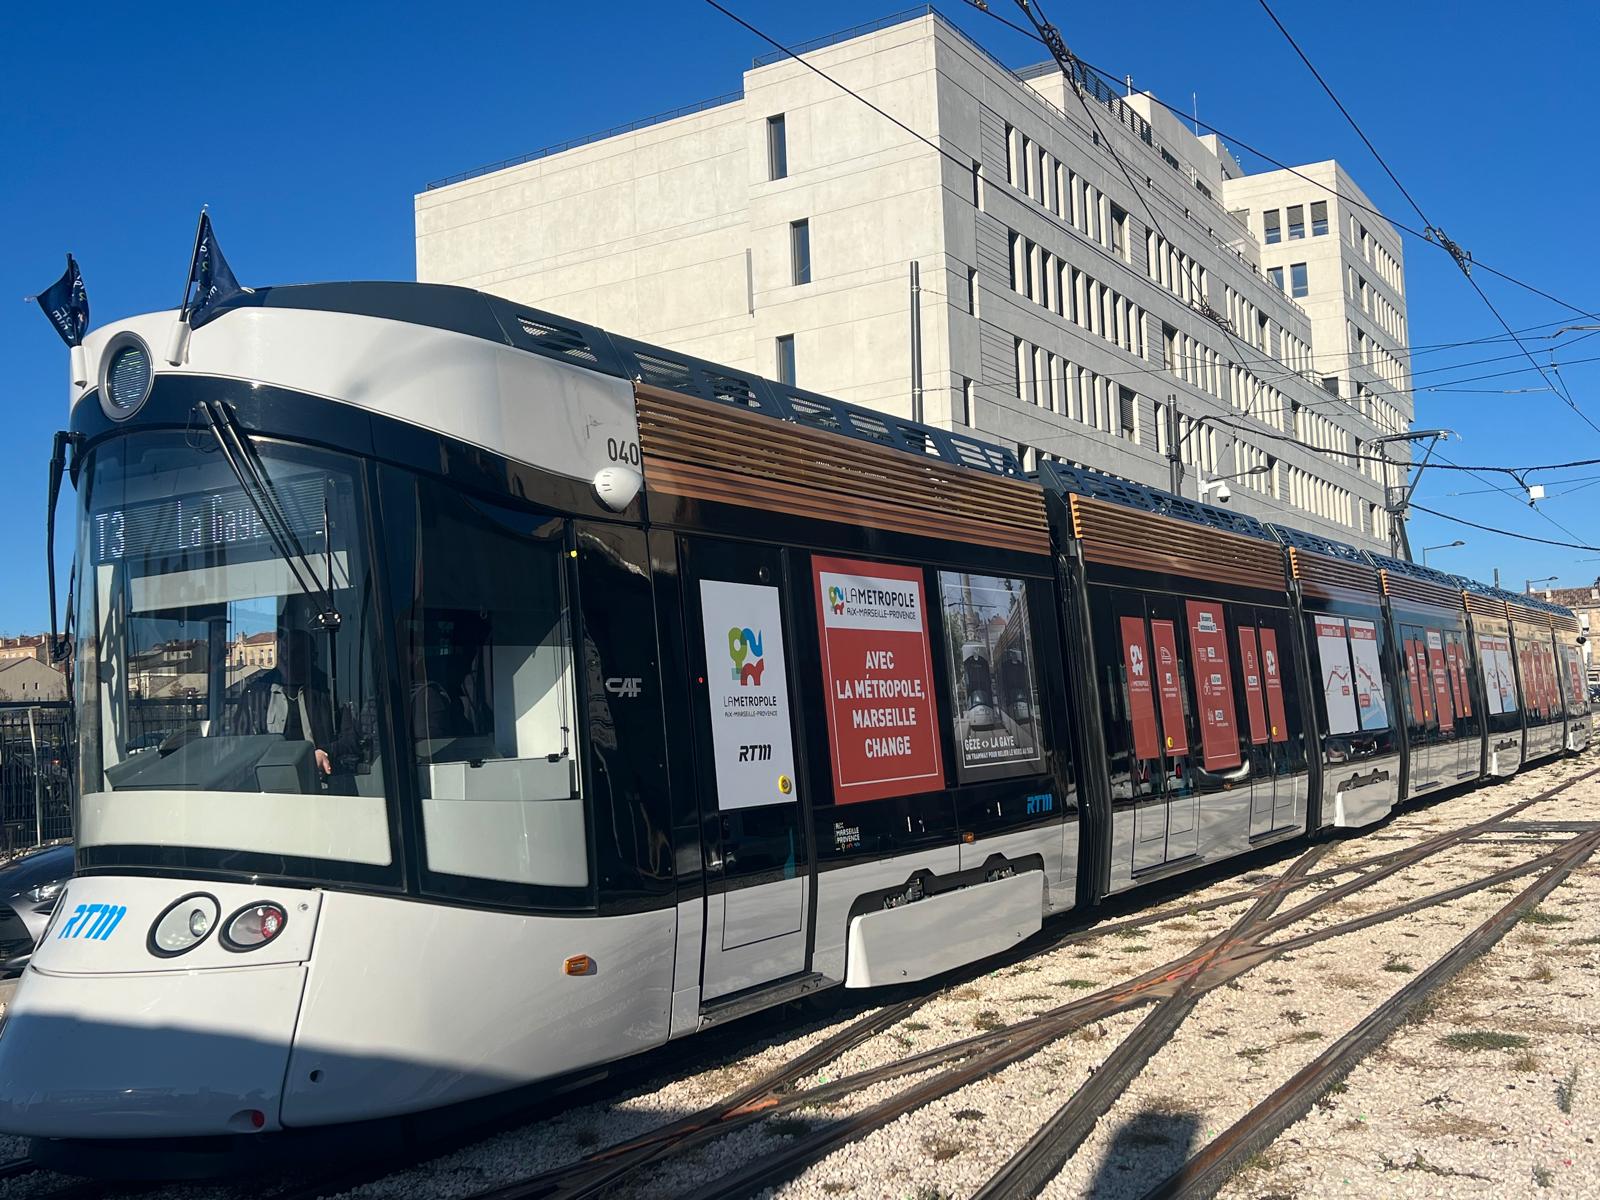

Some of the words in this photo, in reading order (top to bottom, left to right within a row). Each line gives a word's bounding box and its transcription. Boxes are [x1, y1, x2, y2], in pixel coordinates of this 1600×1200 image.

[607, 437, 639, 466] 040
[95, 510, 125, 561] T3
[178, 500, 201, 549] La
[865, 651, 895, 670] AVEC
[605, 677, 643, 698] CAF
[836, 680, 853, 699] LA
[854, 673, 926, 700] MÉTROPOLE,
[852, 707, 917, 729] MARSEILLE
[738, 744, 772, 762] RTM
[865, 735, 912, 758] CHANGE
[964, 735, 981, 751] GÈZE
[990, 737, 999, 748] LA
[1026, 793, 1053, 815] RTM
[57, 903, 128, 941] RTM
